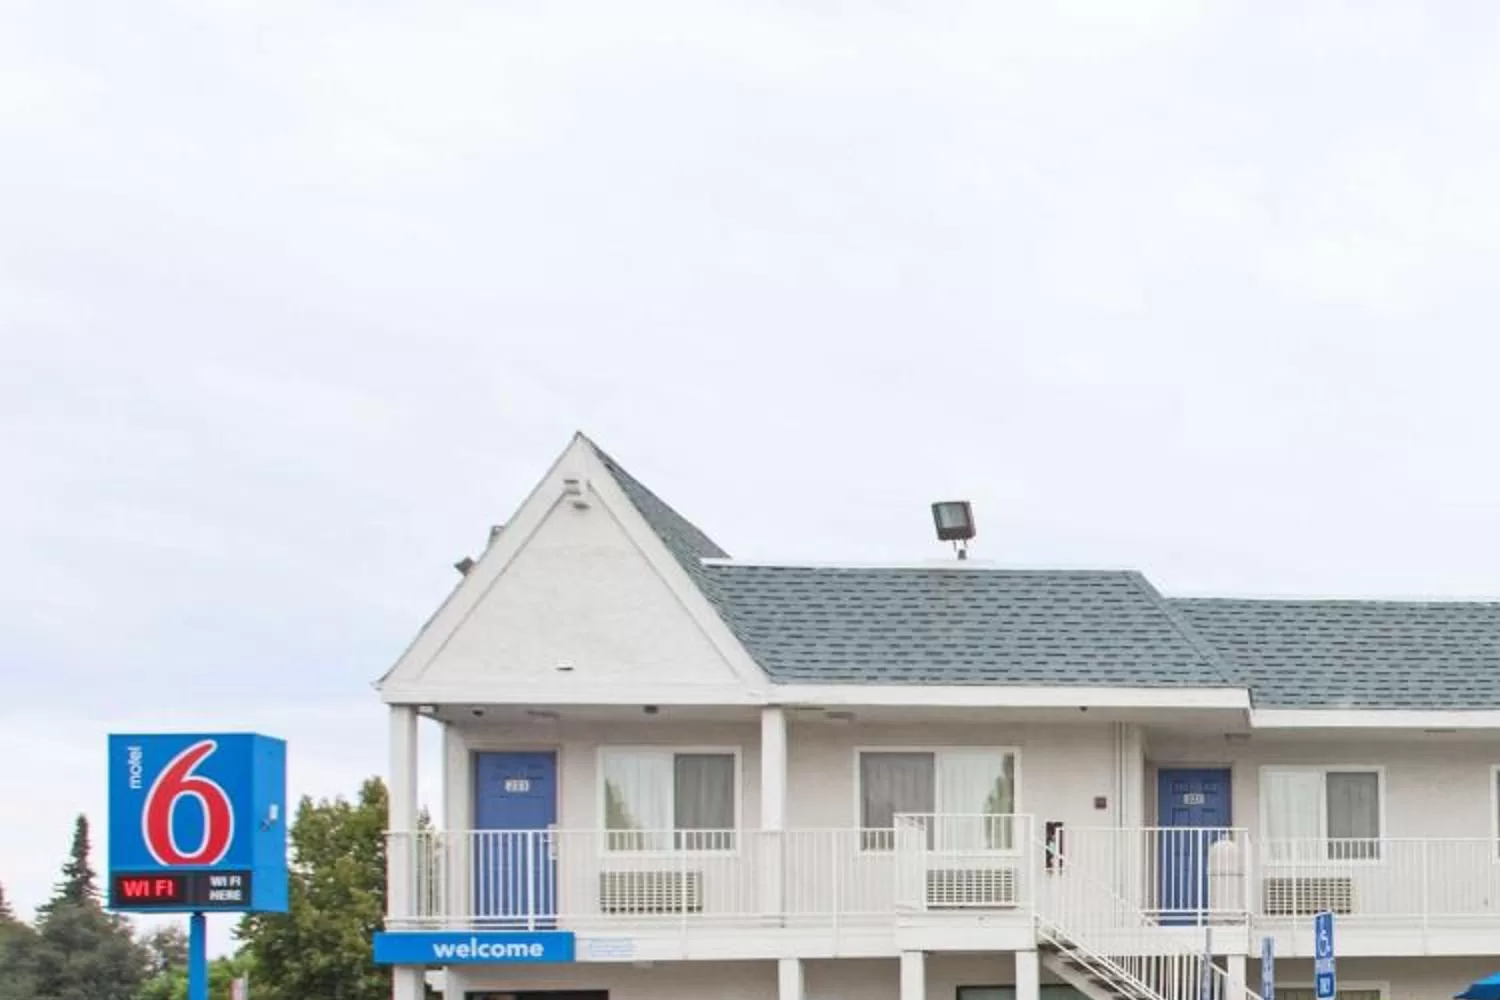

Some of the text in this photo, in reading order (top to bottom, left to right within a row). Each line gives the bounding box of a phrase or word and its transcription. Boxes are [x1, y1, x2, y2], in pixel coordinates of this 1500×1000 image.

[127, 739, 236, 867] motel 6
[123, 880, 174, 897] WI FI
[210, 876, 242, 888] WI FI
[209, 889, 242, 901] HERE
[433, 937, 544, 959] welcome
